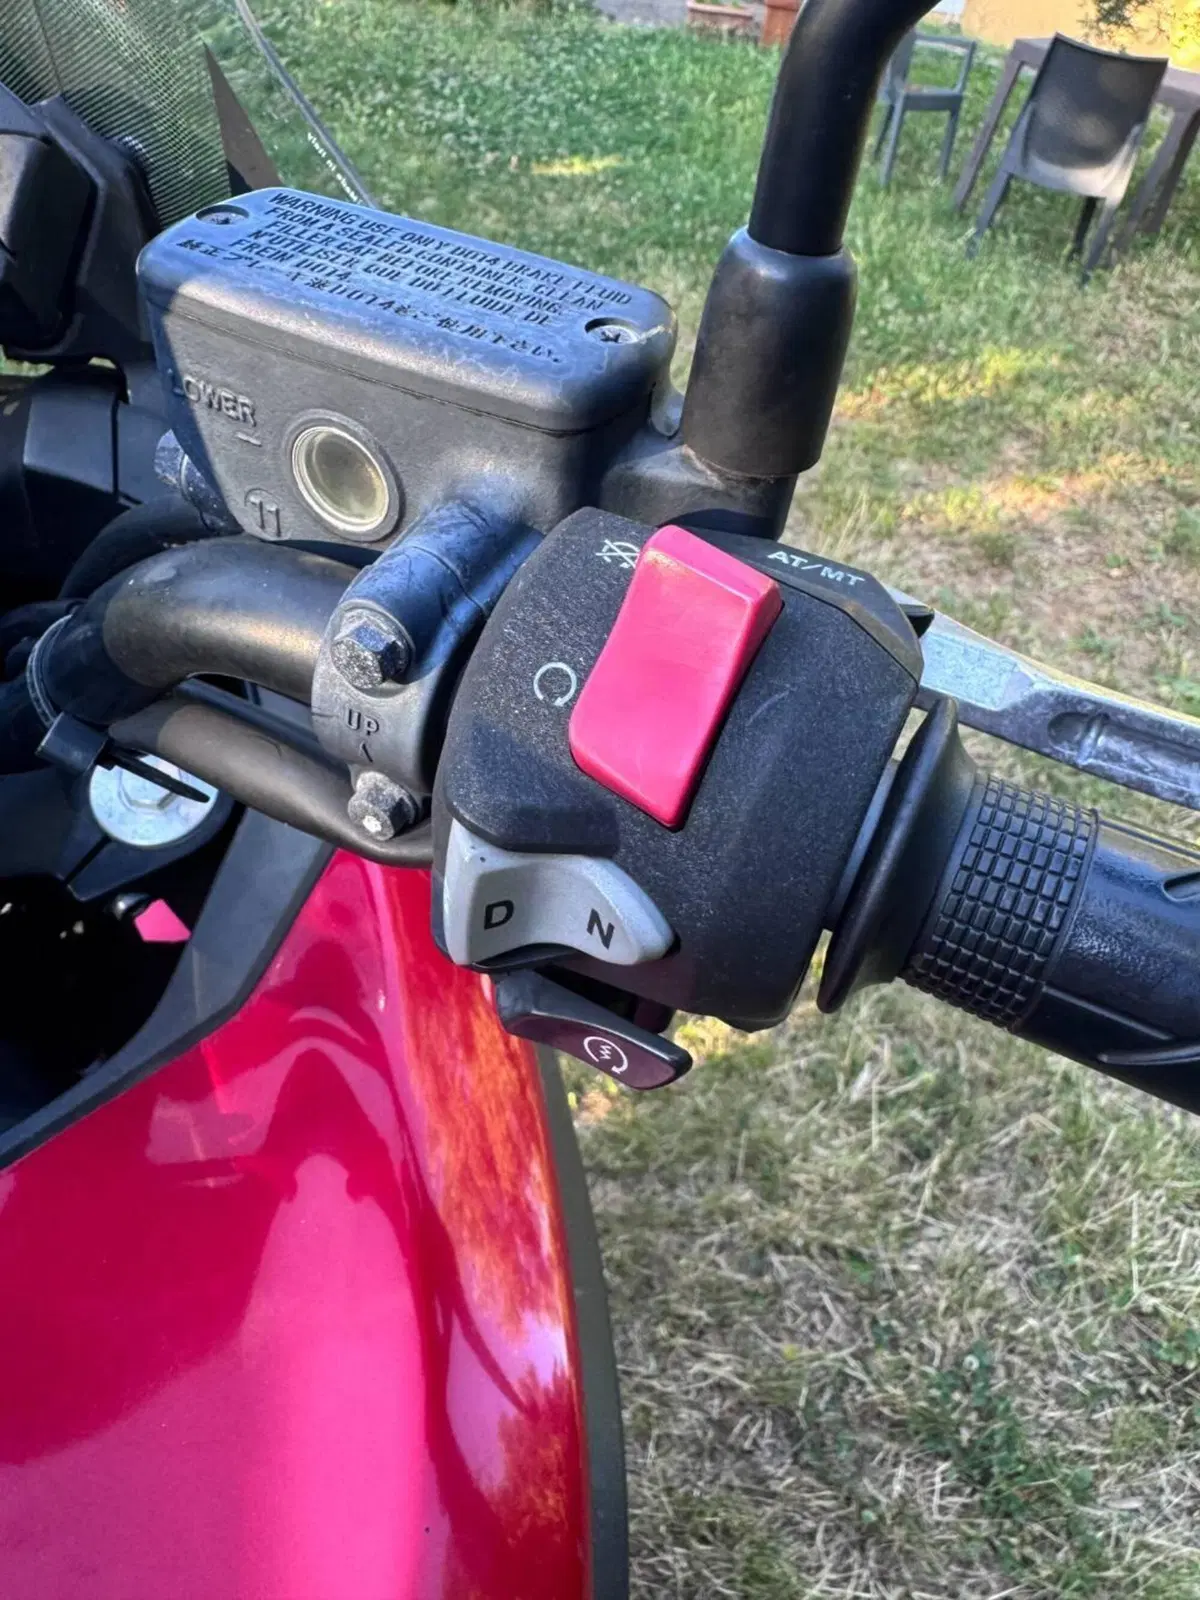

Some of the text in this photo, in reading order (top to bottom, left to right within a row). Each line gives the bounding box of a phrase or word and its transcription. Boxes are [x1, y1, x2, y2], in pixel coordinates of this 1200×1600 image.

[228, 239, 295, 262] FREIN
[264, 206, 320, 227] FROM
[318, 223, 335, 232] A
[335, 228, 413, 254] SEALED
[533, 284, 604, 310] CLEAN
[265, 221, 561, 316] FILLER CAP BEFORE REMOVING.
[268, 193, 632, 304] WARNING USE ONLY DOT4 BRAKE FLUID
[248, 230, 550, 325] N'UTILISER QUE DU FLUIDE DE
[767, 550, 865, 586] AT/MT
[345, 706, 379, 735] UP
[484, 900, 514, 930] D
[586, 908, 615, 950] N
